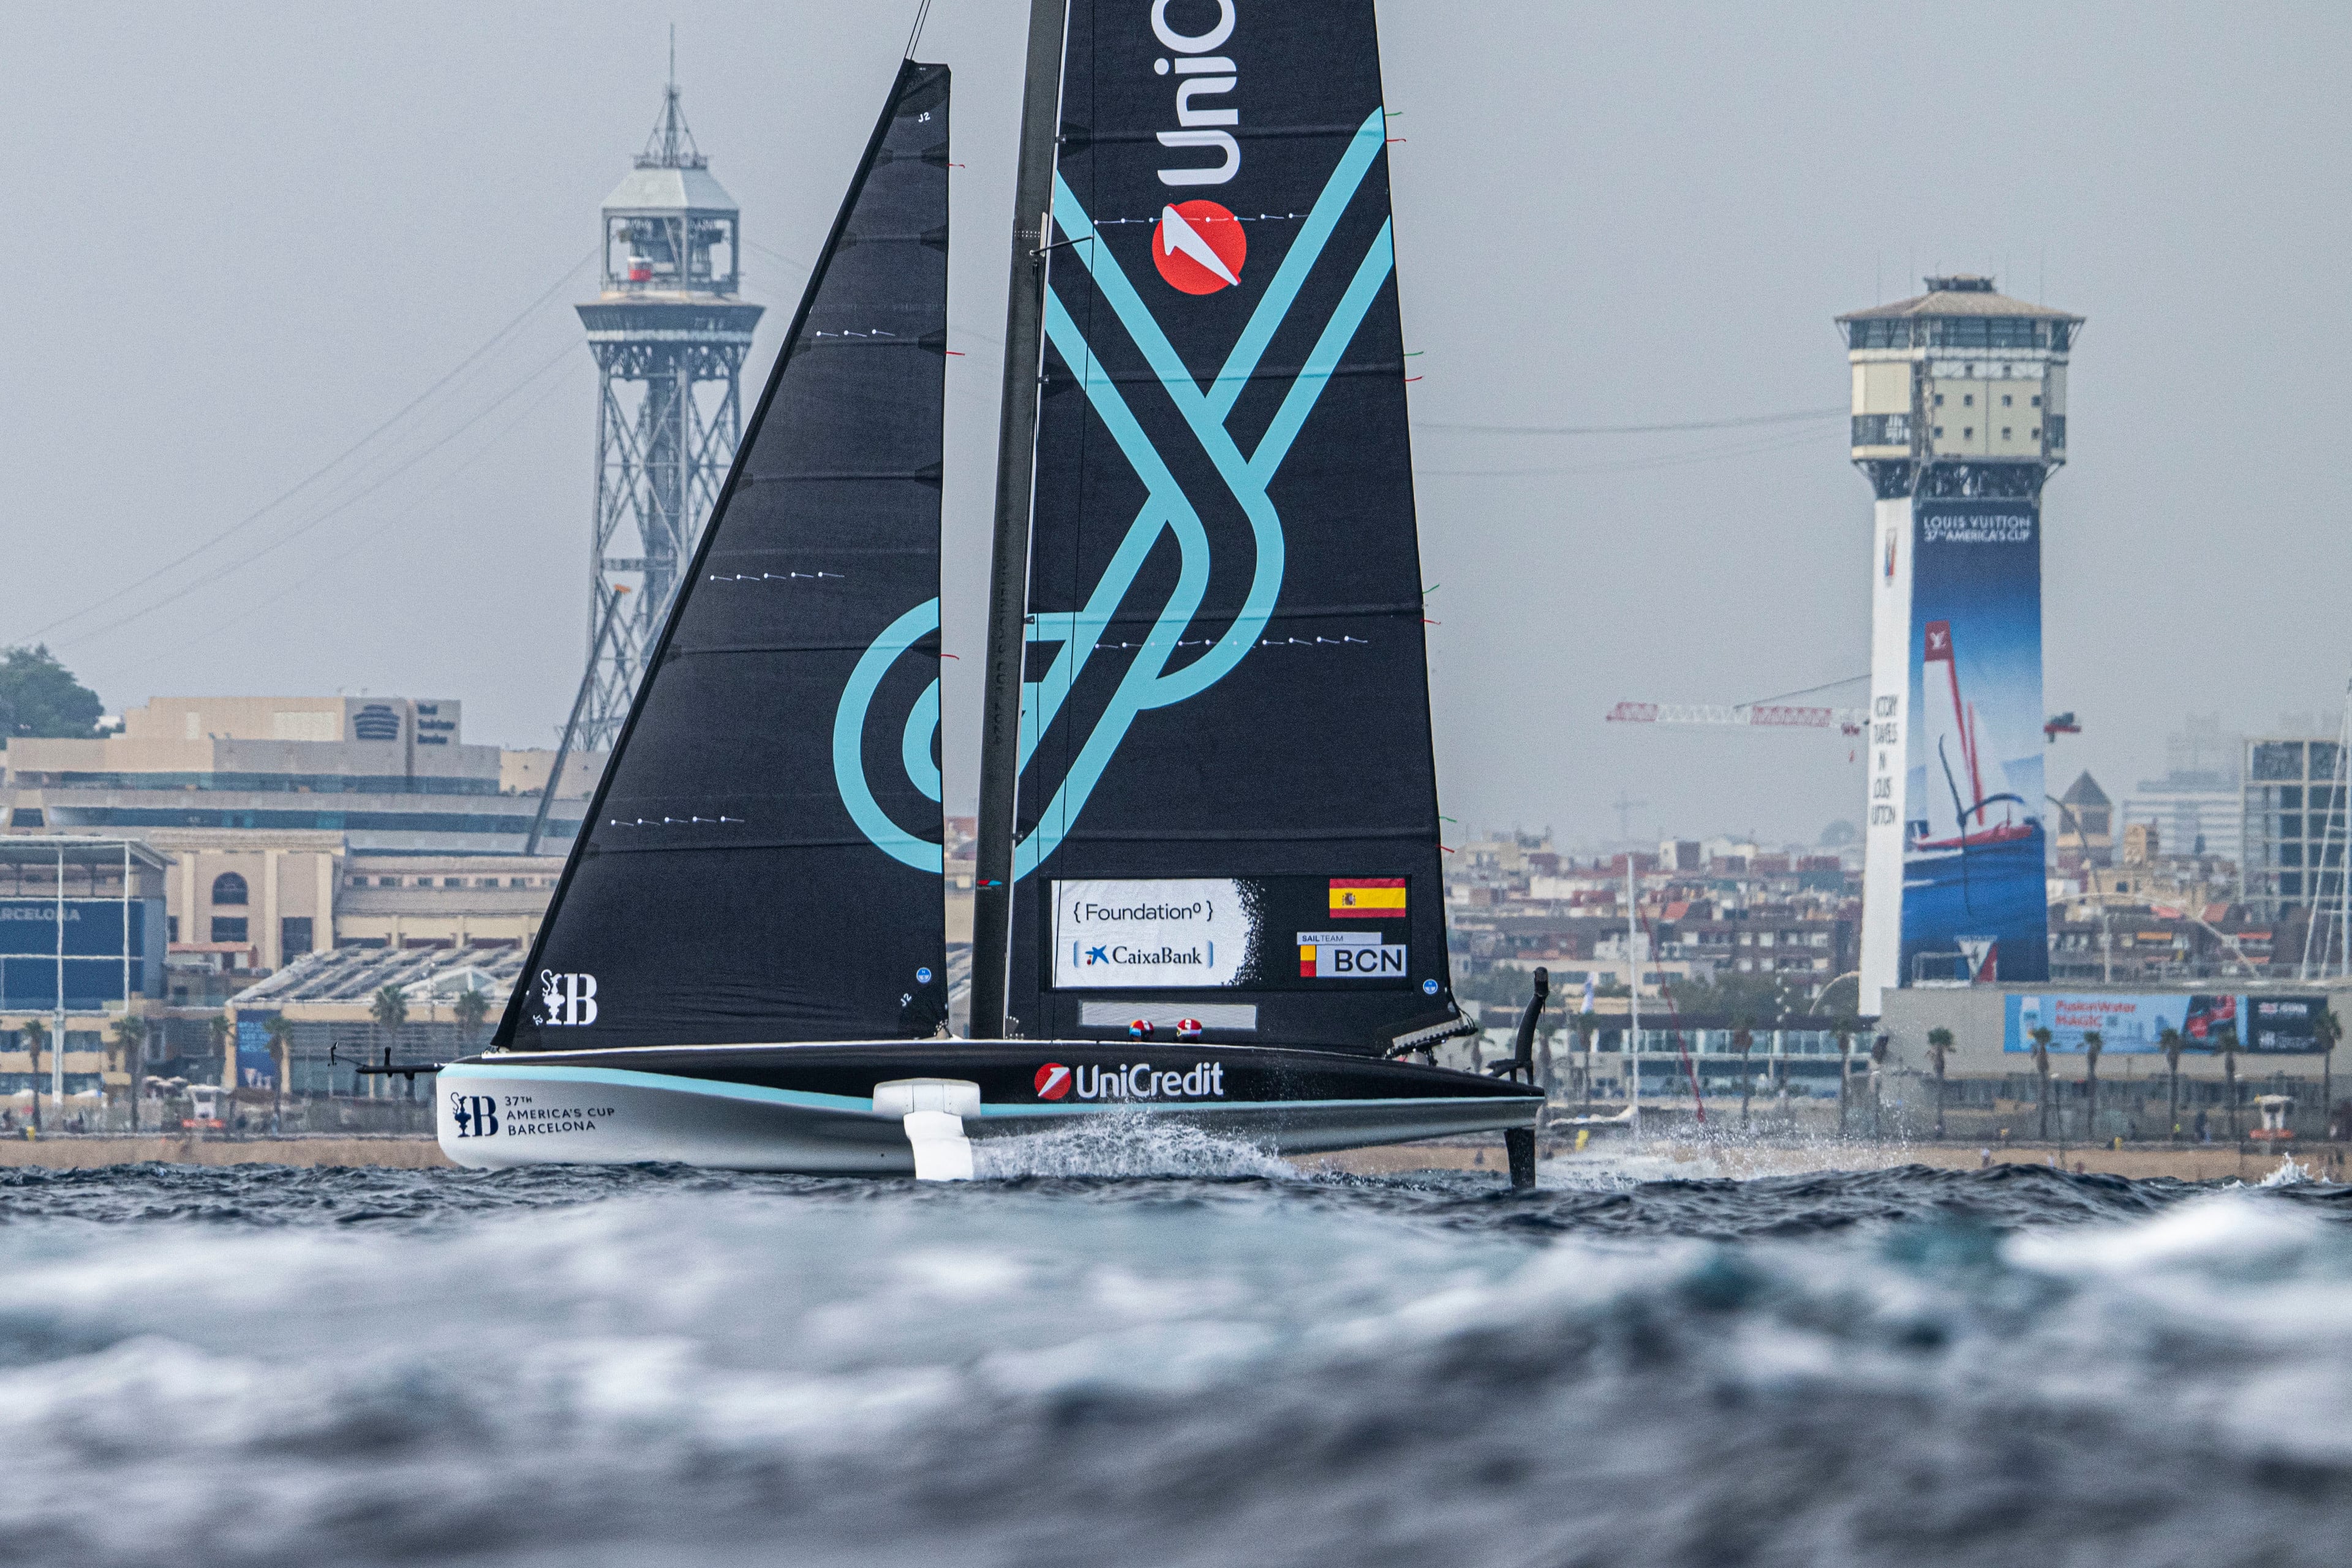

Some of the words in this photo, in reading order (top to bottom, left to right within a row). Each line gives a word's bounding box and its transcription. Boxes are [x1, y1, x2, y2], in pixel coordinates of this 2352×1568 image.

[1923, 515, 1966, 529] LOUIS
[1969, 515, 2031, 529] VUITTON
[0, 908, 81, 921] RCELOA
[1112, 946, 1202, 965] CaixaBank
[1334, 949, 1402, 973] BCN
[900, 993, 911, 1007] J2
[532, 1014, 543, 1026] J2
[1076, 1061, 1224, 1098] UniCredit
[507, 1107, 581, 1120] AMERICA'S
[587, 1107, 615, 1117] CUP
[508, 1120, 596, 1136] BARCELONA
